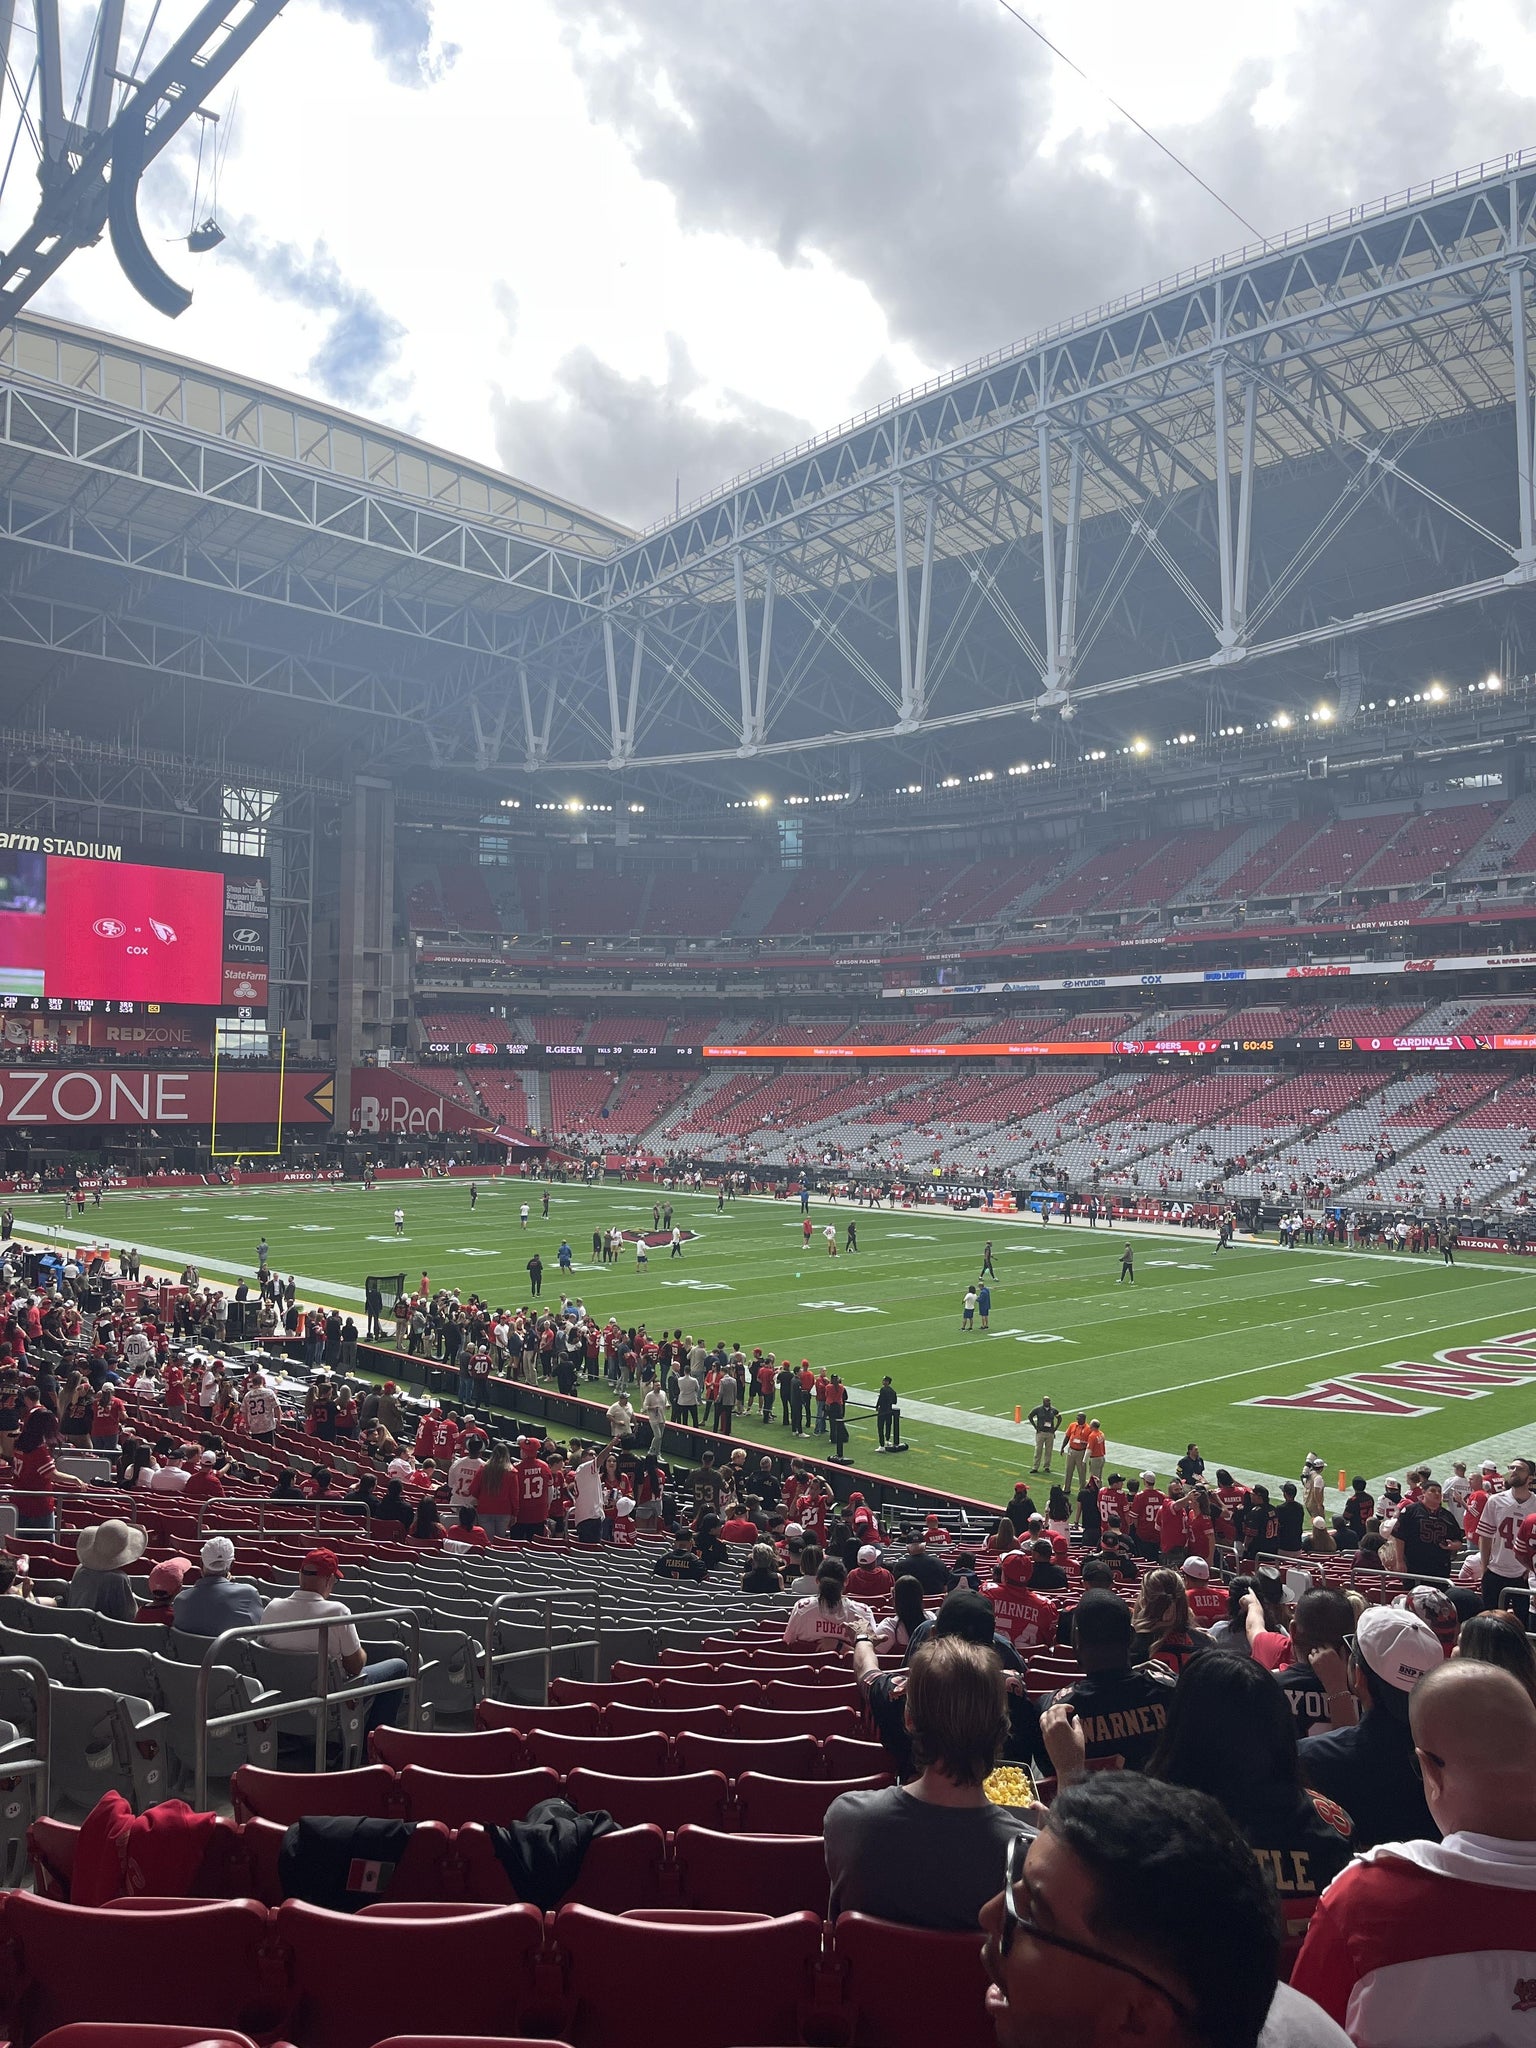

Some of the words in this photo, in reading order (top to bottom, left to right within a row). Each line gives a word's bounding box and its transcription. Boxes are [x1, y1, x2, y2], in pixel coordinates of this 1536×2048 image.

[43, 838, 122, 861] STADIUM
[1351, 922, 1377, 930] LARRY
[1379, 919, 1410, 927] WILSON
[126, 946, 149, 955] COX
[228, 944, 264, 952] HYUNDAI
[224, 970, 246, 980] State
[246, 971, 267, 981] Farm
[1222, 971, 1244, 980] LIGHT
[1302, 967, 1326, 977] State
[1326, 966, 1350, 976] Farm
[1074, 979, 1105, 987] HYUNDAI
[1141, 976, 1162, 984] COX
[239, 1008, 251, 1017] 25
[107, 1027, 191, 1043] REDZONE
[1155, 1042, 1181, 1050] 49ERS
[1198, 1042, 1205, 1050] 0
[1243, 1041, 1274, 1050] 60:45
[1340, 1040, 1350, 1048] 25
[1371, 1039, 1380, 1049] 0
[1393, 1038, 1453, 1047] CARDINALS
[1503, 1038, 1519, 1046] Make
[545, 1046, 583, 1054] R.GREEN
[0, 1072, 189, 1121] ZONE
[391, 1096, 444, 1140] Red
[284, 1172, 323, 1180] ARIZOA
[988, 1328, 1065, 1344] 10
[474, 1362, 488, 1374] 40
[249, 1400, 265, 1415] 23
[523, 1476, 544, 1499] 13
[694, 1484, 714, 1500] 53
[1420, 1519, 1448, 1543] 52
[1194, 1595, 1220, 1607] RICE
[994, 1600, 1039, 1623] WARNER
[1081, 1703, 1167, 1744] WARNER
[1252, 1848, 1316, 1891] TLE
